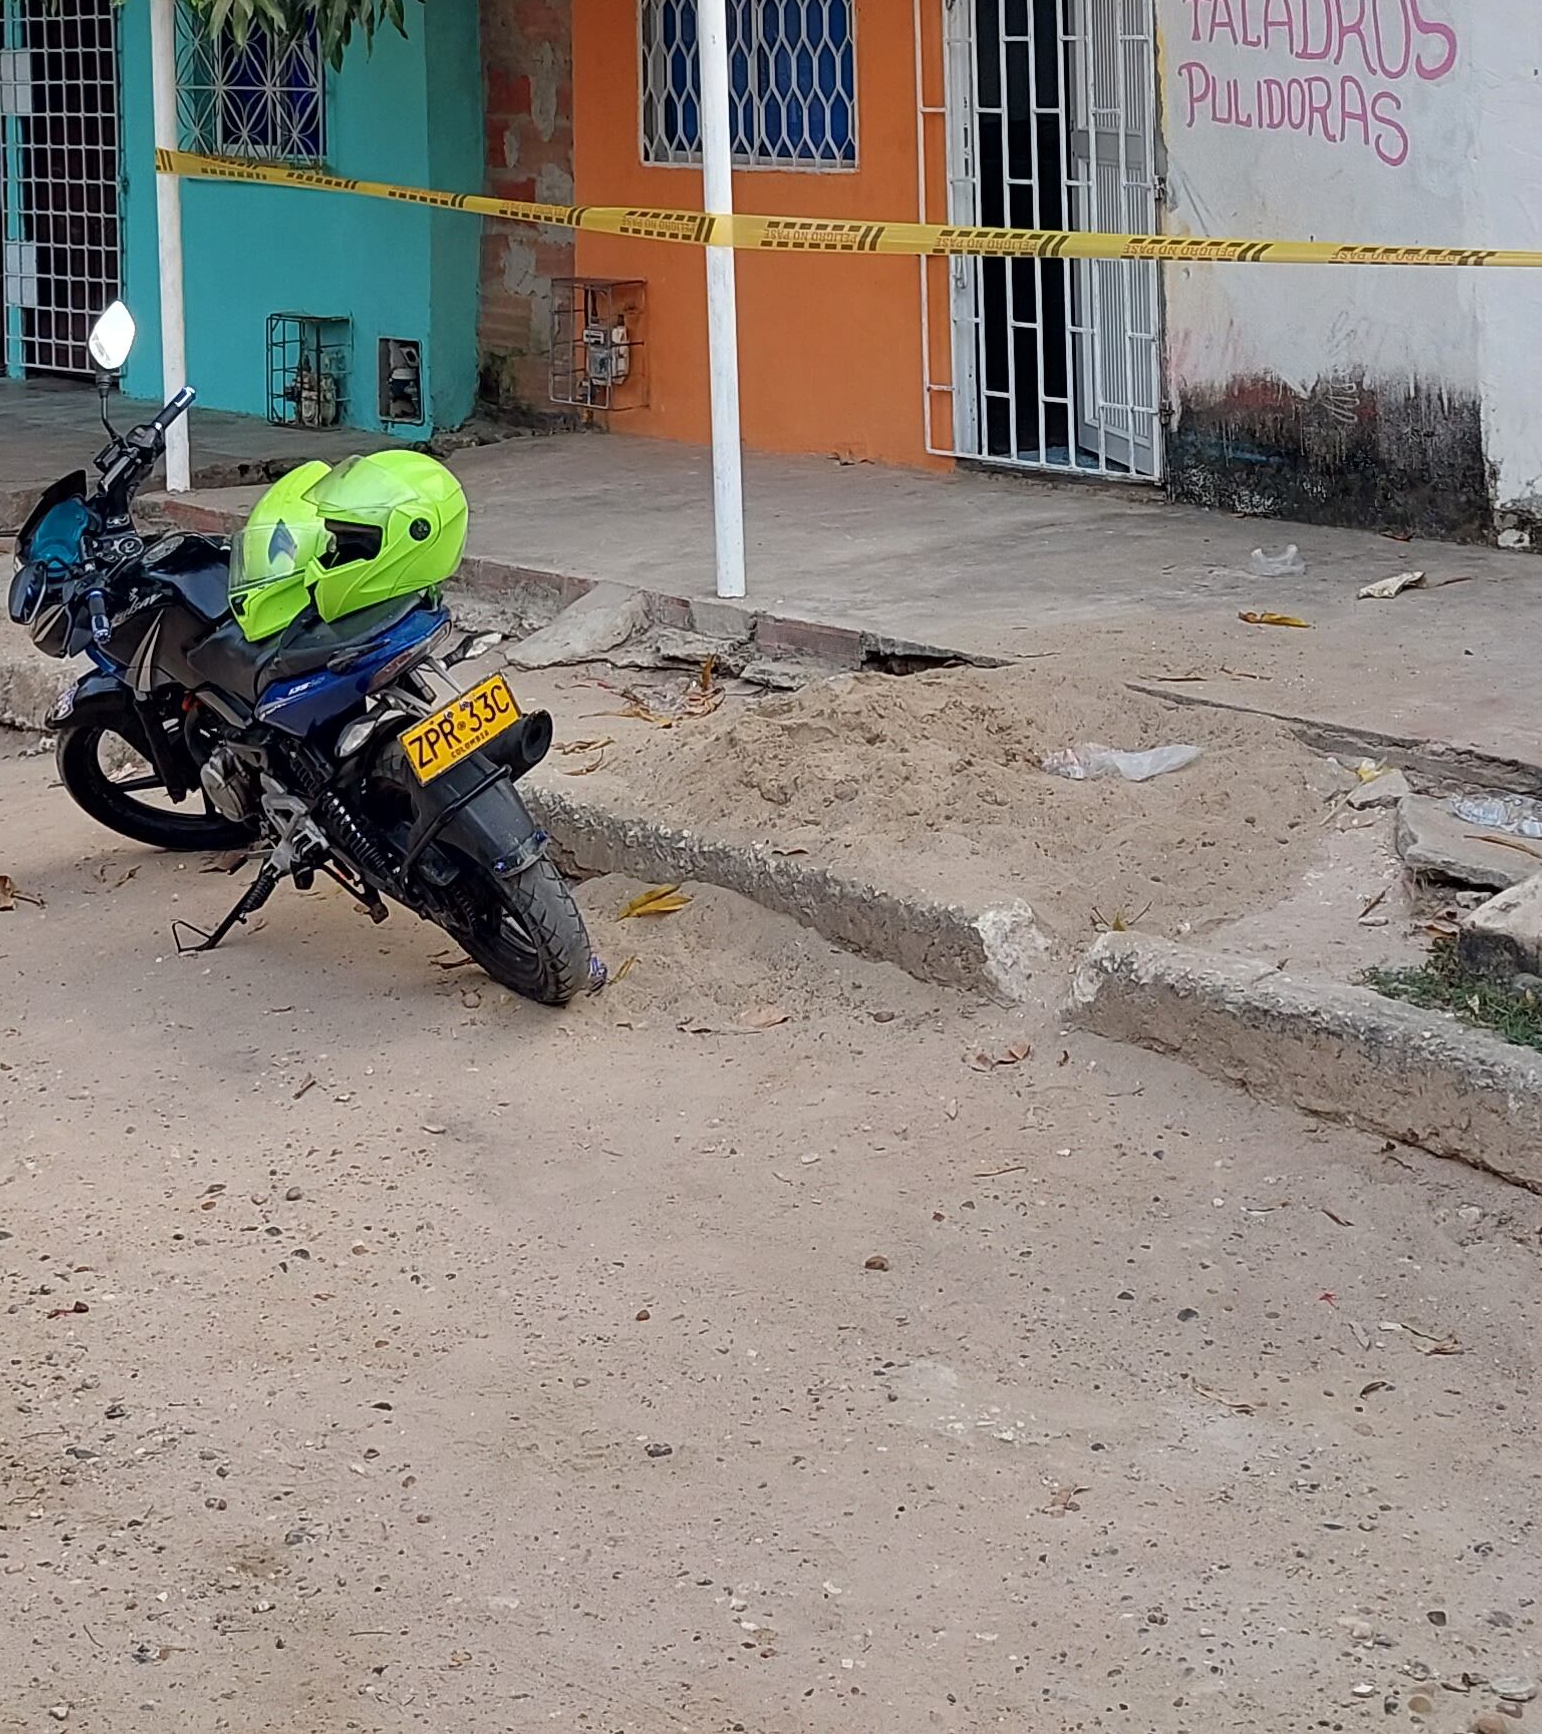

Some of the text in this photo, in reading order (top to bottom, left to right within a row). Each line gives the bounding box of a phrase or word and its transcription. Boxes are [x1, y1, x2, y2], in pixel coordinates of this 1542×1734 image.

[1178, 61, 1410, 167] PULIDORAS
[762, 229, 858, 243] PELIGRO NO PASE
[933, 237, 1038, 251] PELIGRO NO PASE
[1121, 244, 1237, 256] PELIGRO NO PASE
[450, 729, 491, 759] COLOMBIA
